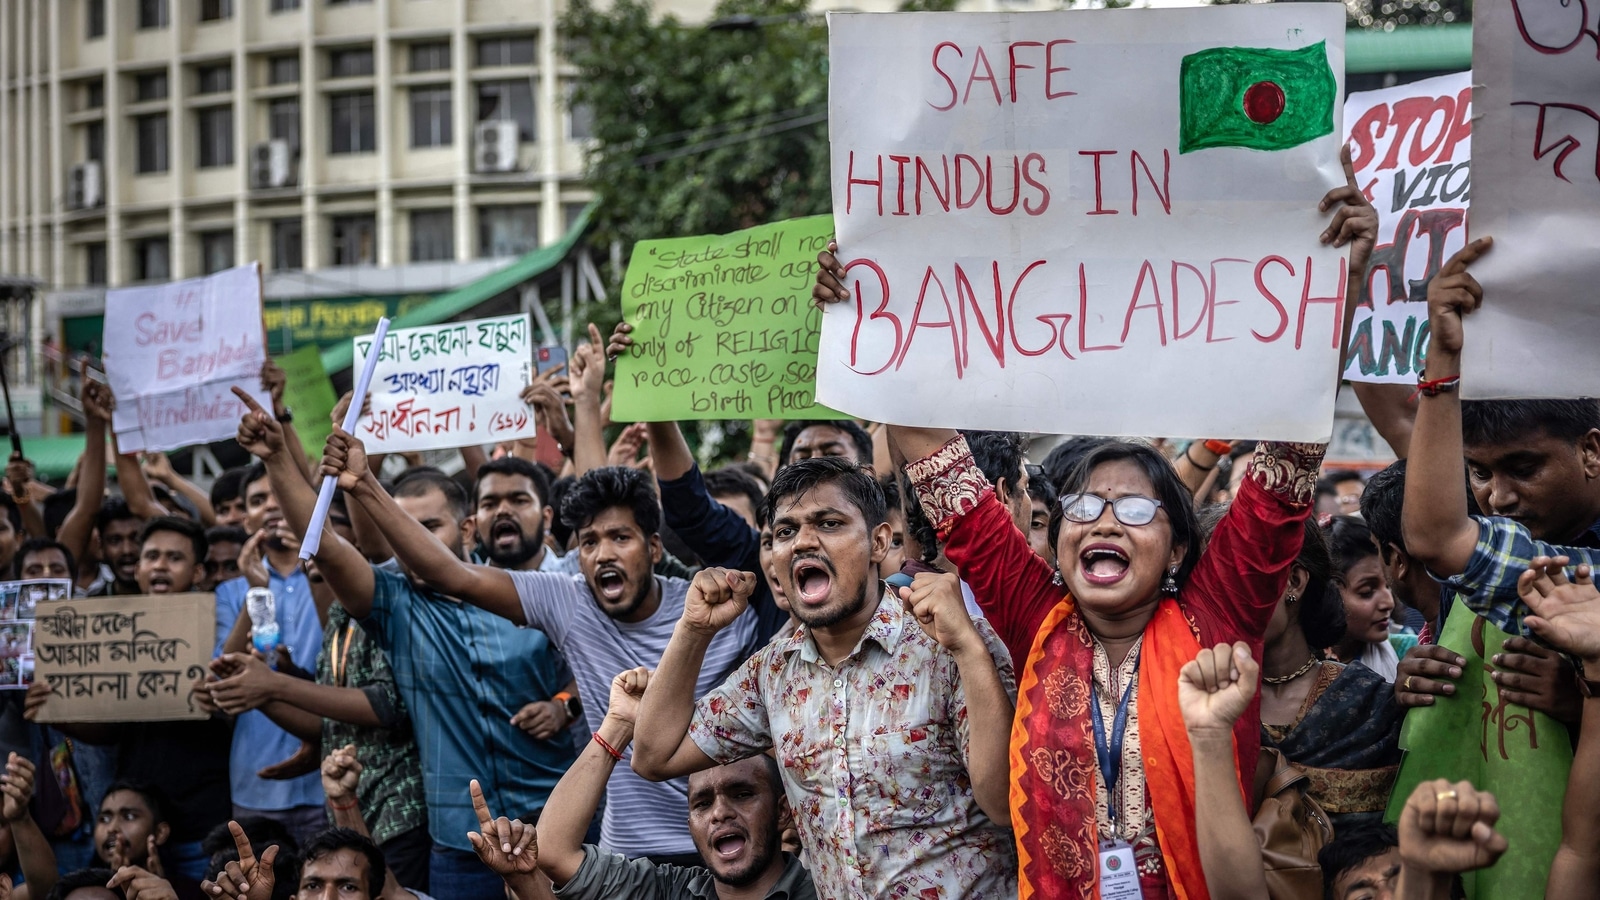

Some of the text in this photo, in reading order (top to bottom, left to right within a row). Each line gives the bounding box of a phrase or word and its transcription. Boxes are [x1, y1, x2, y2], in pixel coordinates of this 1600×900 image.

[925, 39, 1078, 111] SAFE
[1351, 87, 1472, 174] STOP
[846, 149, 1171, 216] HINDUS IN
[732, 231, 784, 260] shall
[631, 262, 770, 298] discriminate
[686, 292, 763, 327] Citizen
[771, 295, 798, 316] on
[840, 255, 1346, 380] BANGLADESH
[134, 311, 204, 347] Save
[631, 336, 666, 367] only
[675, 332, 702, 358] of
[690, 389, 752, 413] birth
[36, 631, 189, 667] আমার মন্দিরে
[44, 672, 131, 700] হামলা
